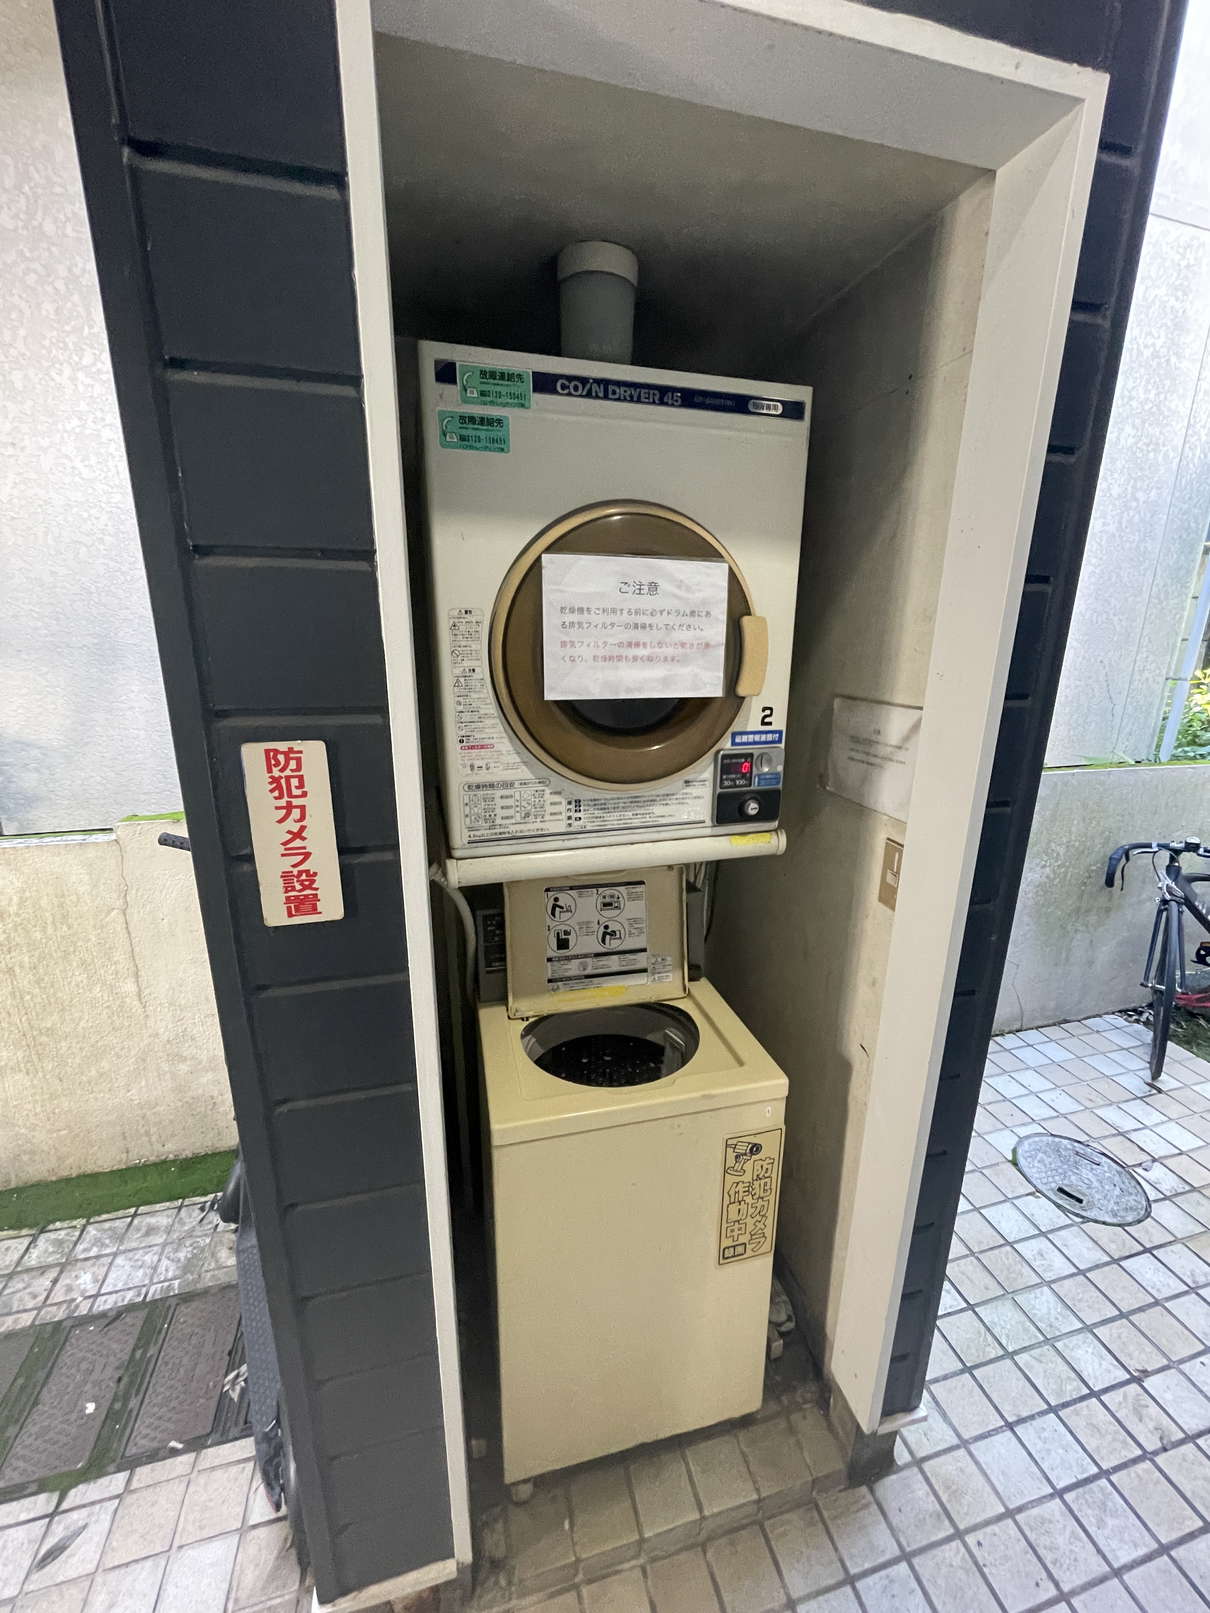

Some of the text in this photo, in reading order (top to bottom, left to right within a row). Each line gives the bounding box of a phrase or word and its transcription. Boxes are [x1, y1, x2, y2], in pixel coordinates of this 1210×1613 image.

[480, 369, 525, 384] 故障連絡先
[556, 379, 603, 398] COIN
[608, 385, 660, 405] DRYER
[663, 392, 682, 406] 45
[459, 415, 504, 428] 故障連絡先
[618, 581, 660, 597] ご注意
[761, 707, 773, 726] 2
[264, 746, 322, 918] 防犯カメラ設置
[726, 1181, 751, 1242] 作動中
[749, 1158, 774, 1251] 防犯カメラ
